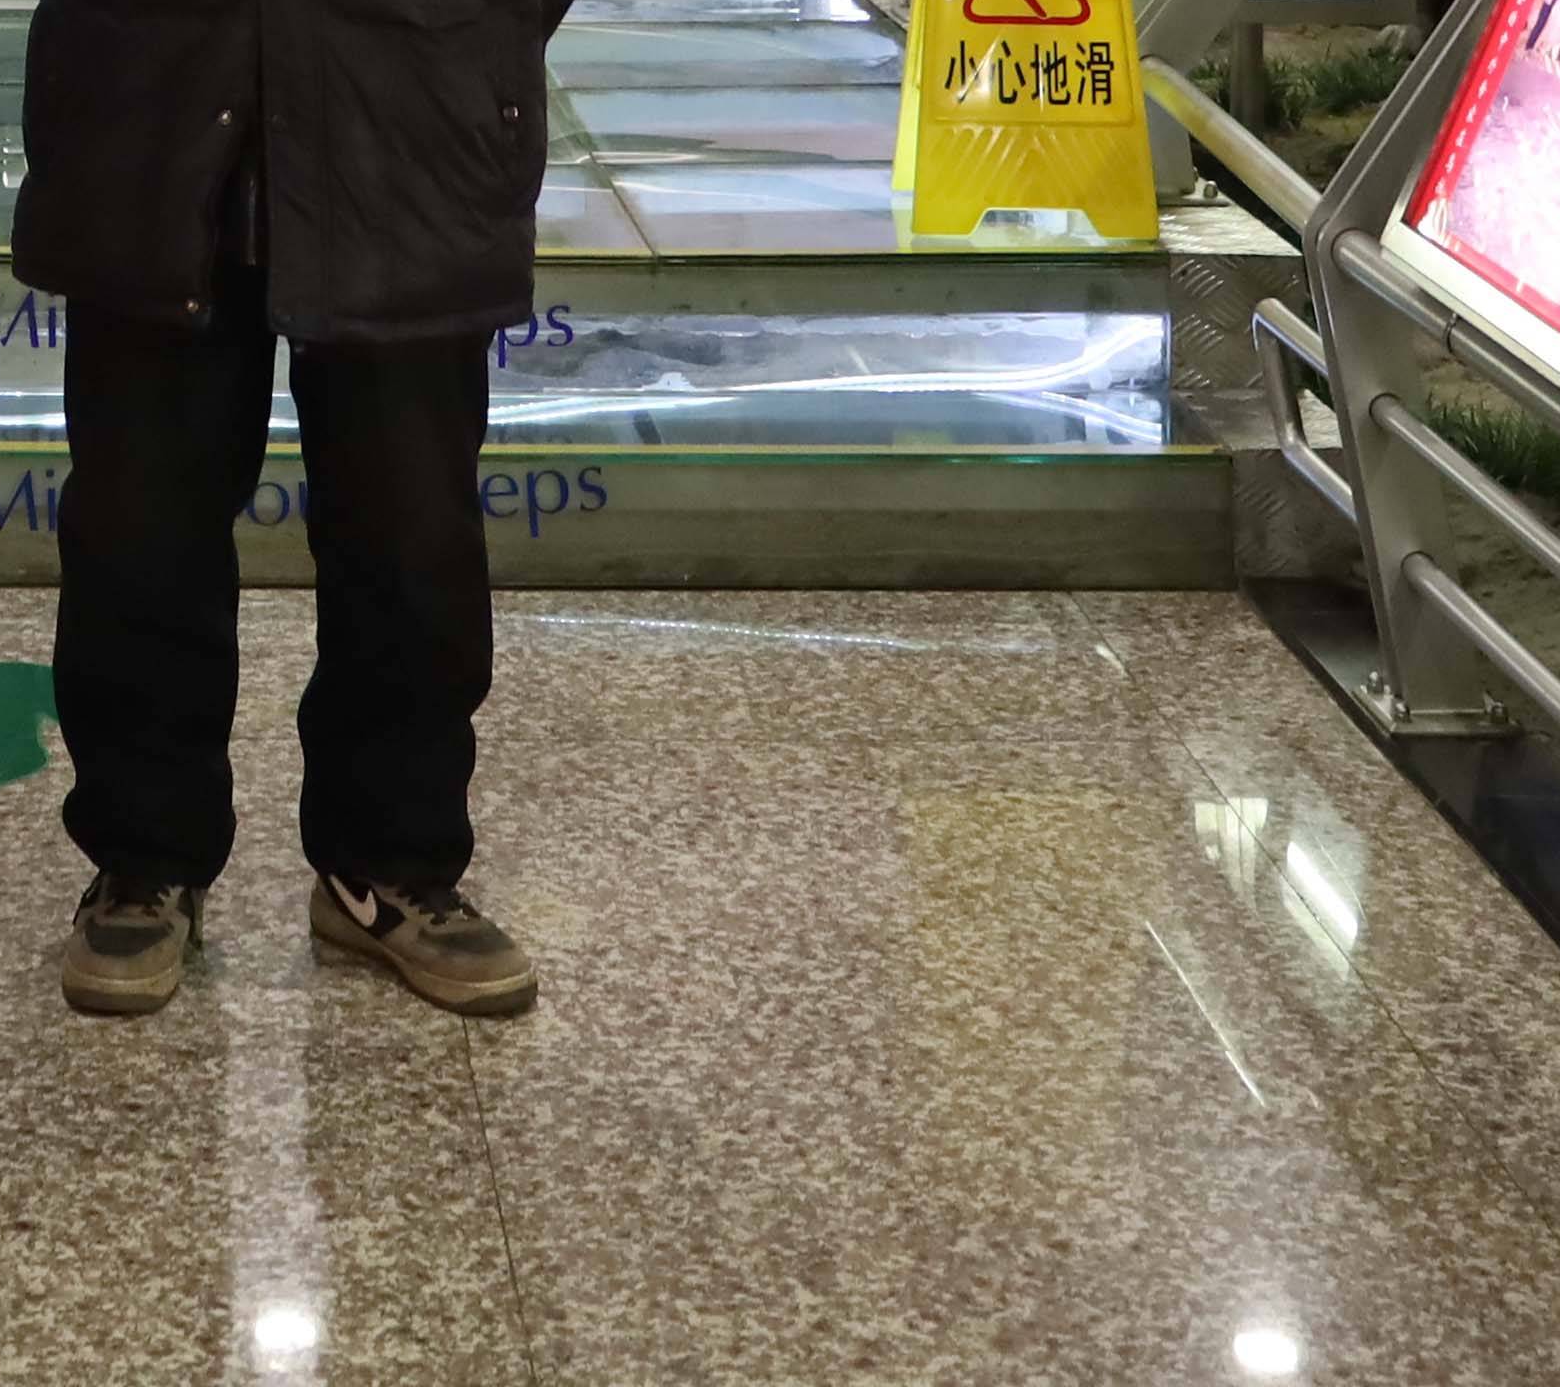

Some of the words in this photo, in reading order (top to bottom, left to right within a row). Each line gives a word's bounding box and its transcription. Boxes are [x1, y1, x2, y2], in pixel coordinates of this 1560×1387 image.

[944, 40, 1115, 106] 小心地滑
[481, 466, 608, 538] eps
